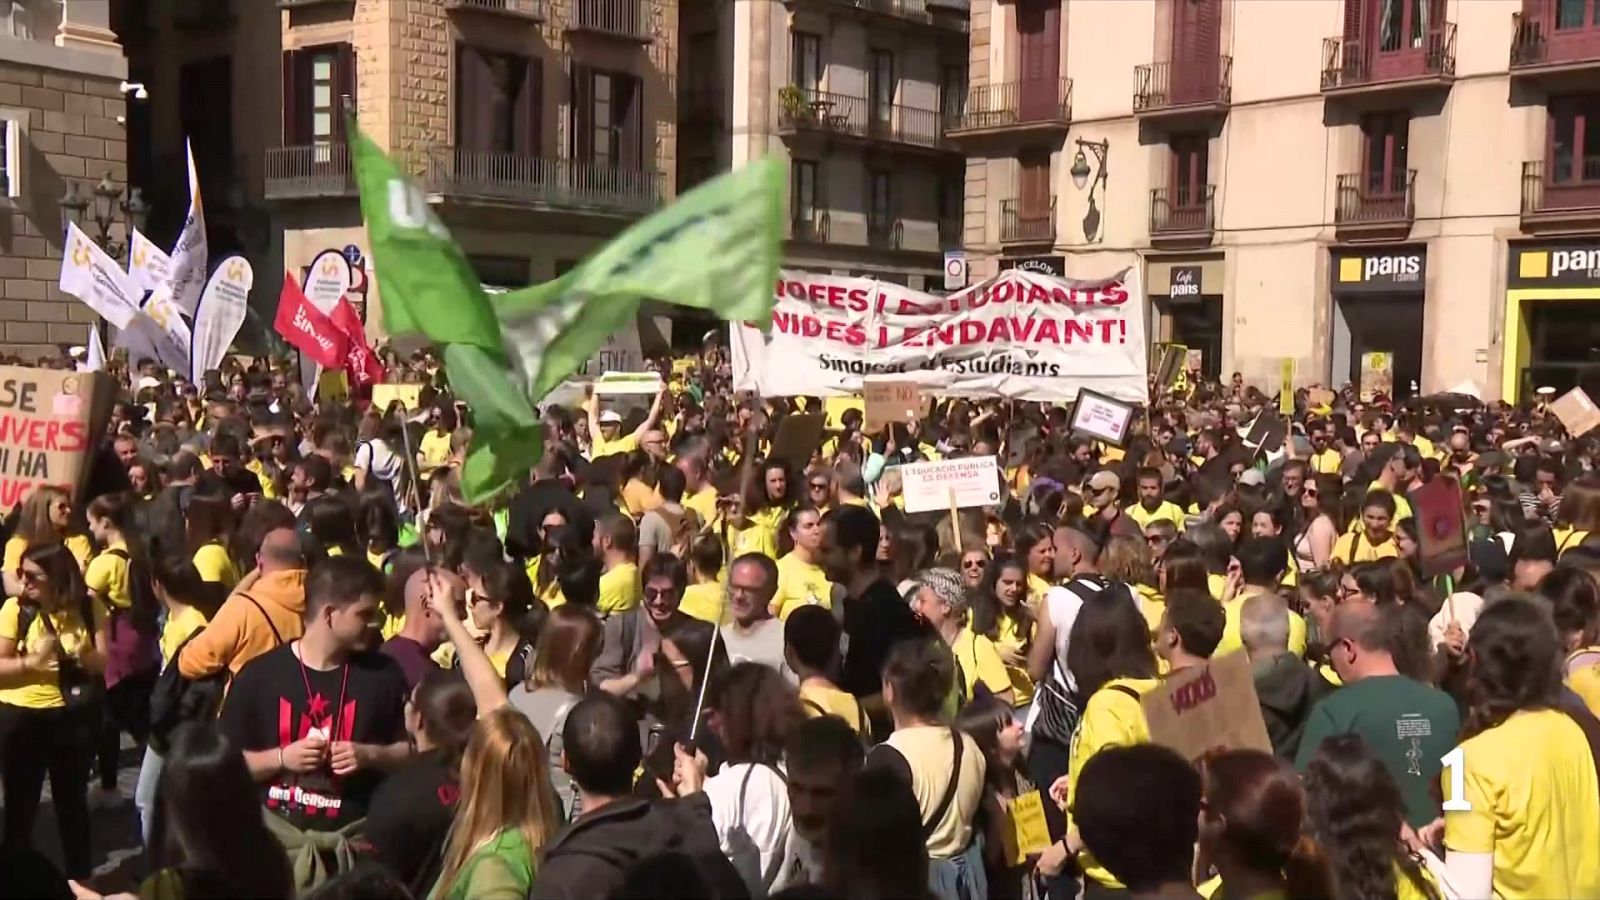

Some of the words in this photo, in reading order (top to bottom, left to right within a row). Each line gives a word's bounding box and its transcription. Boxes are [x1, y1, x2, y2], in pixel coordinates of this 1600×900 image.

[1365, 256, 1420, 281] pans
[877, 292, 887, 314] I
[1171, 284, 1198, 298] pans
[744, 311, 866, 346] NIDES
[878, 326, 888, 348] I
[903, 316, 1126, 347] ENDAVANT!
[16, 450, 48, 478] HA
